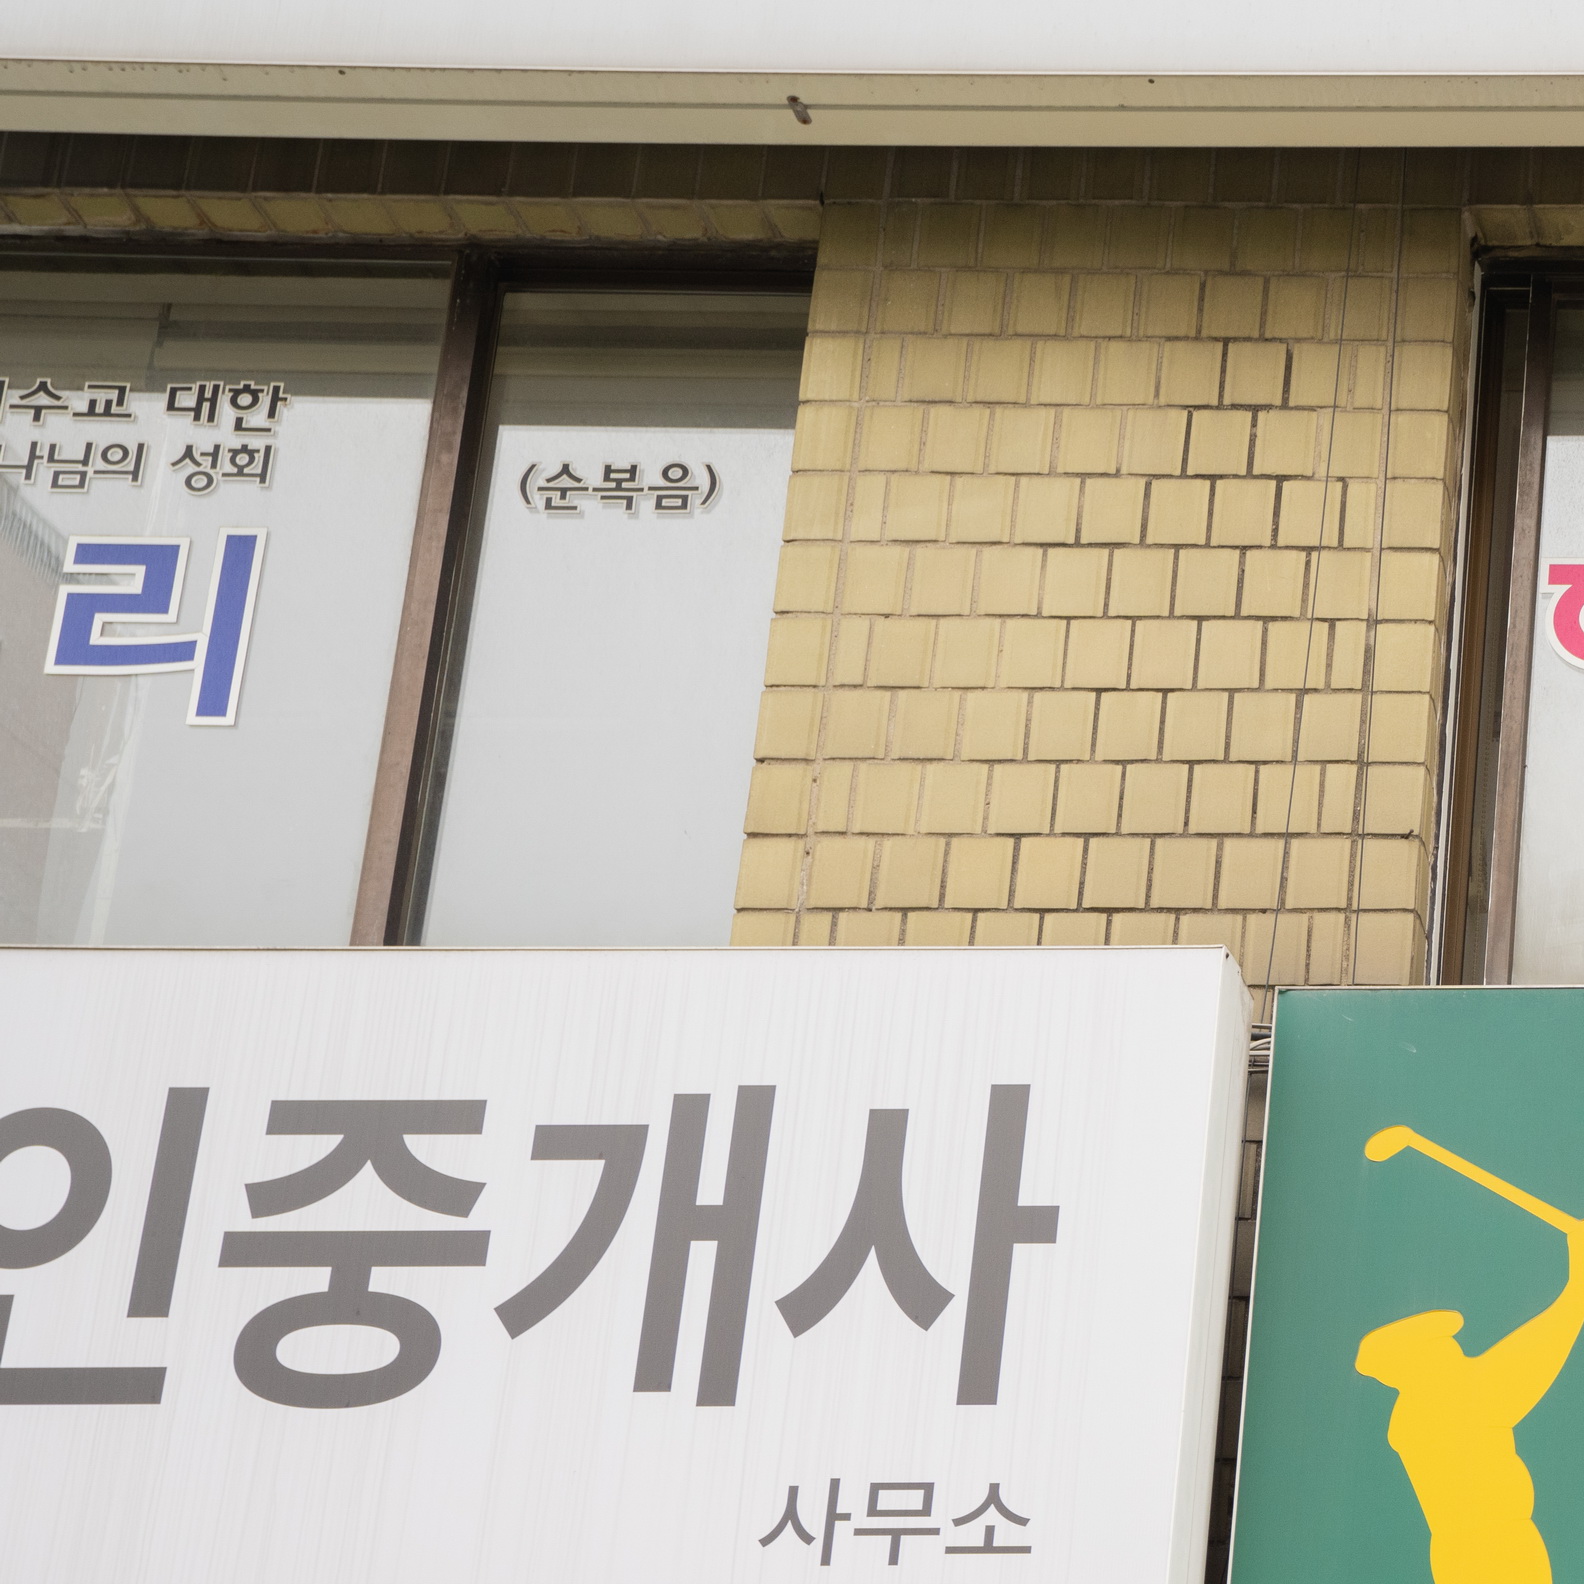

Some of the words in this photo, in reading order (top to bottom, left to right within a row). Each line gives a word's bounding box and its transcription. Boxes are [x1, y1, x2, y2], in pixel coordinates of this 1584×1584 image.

[0, 378, 134, 423] 수교
[166, 381, 289, 433] 대한
[170, 443, 273, 493] 성회
[519, 462, 721, 513] (순복음)
[46, 528, 267, 724] 리
[0, 1083, 1060, 1409] 인중개사
[758, 1476, 1034, 1567] 사무소
